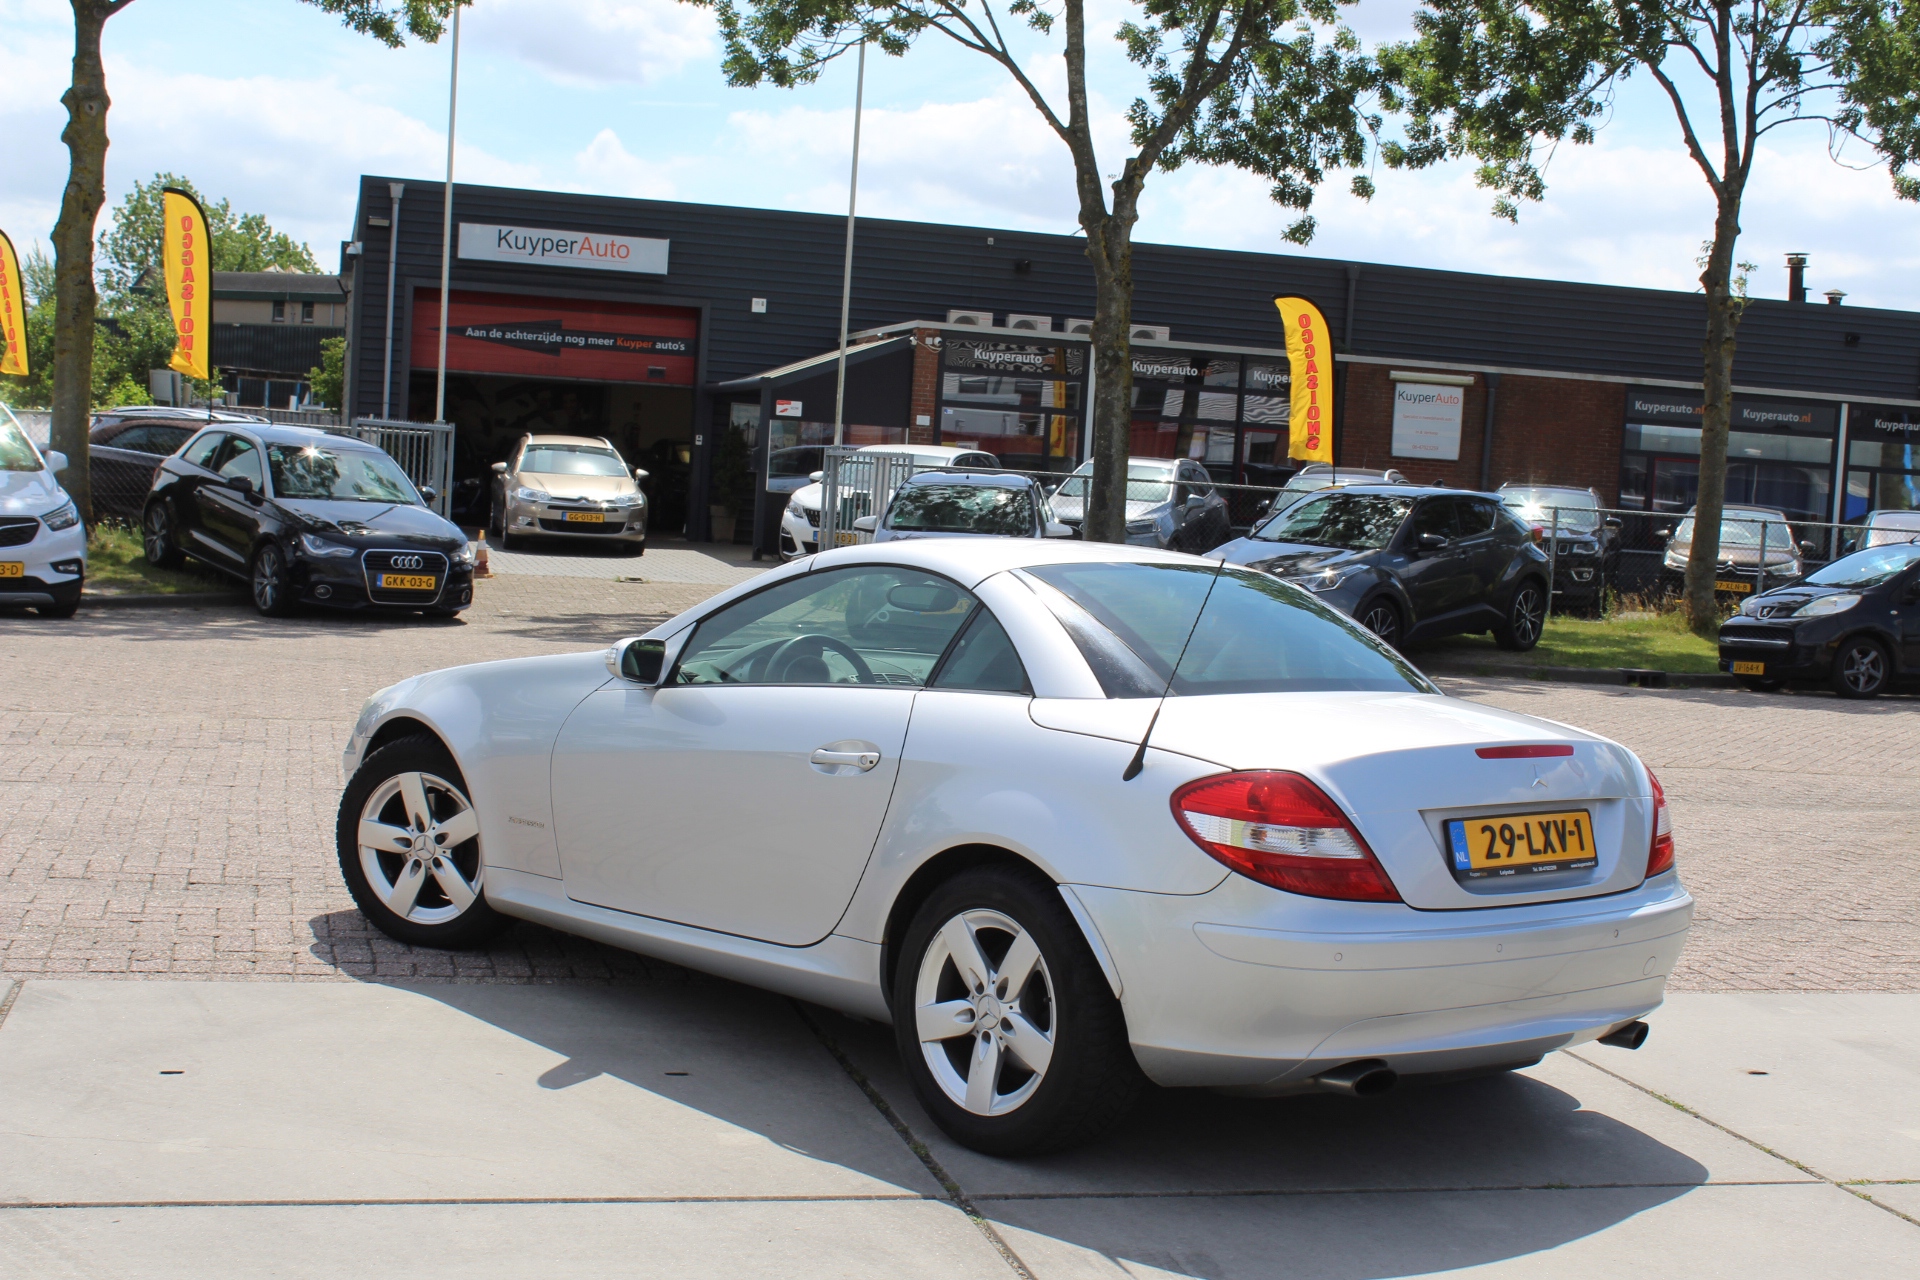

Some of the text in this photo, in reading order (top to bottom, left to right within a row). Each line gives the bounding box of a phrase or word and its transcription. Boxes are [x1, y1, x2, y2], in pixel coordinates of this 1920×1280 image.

[497, 228, 631, 259] KuyperAuto
[465, 327, 685, 351] Aan de achterzijde nog meer Kuyper auto's
[1397, 390, 1460, 405] KuyperAuto
[1743, 408, 1812, 423] Kuyperauto.nl
[568, 513, 601, 521] GG-013-H
[385, 576, 433, 588] GKK-03-G
[1481, 818, 1585, 860] 29-LXV-1
[1455, 852, 1469, 863] NL
